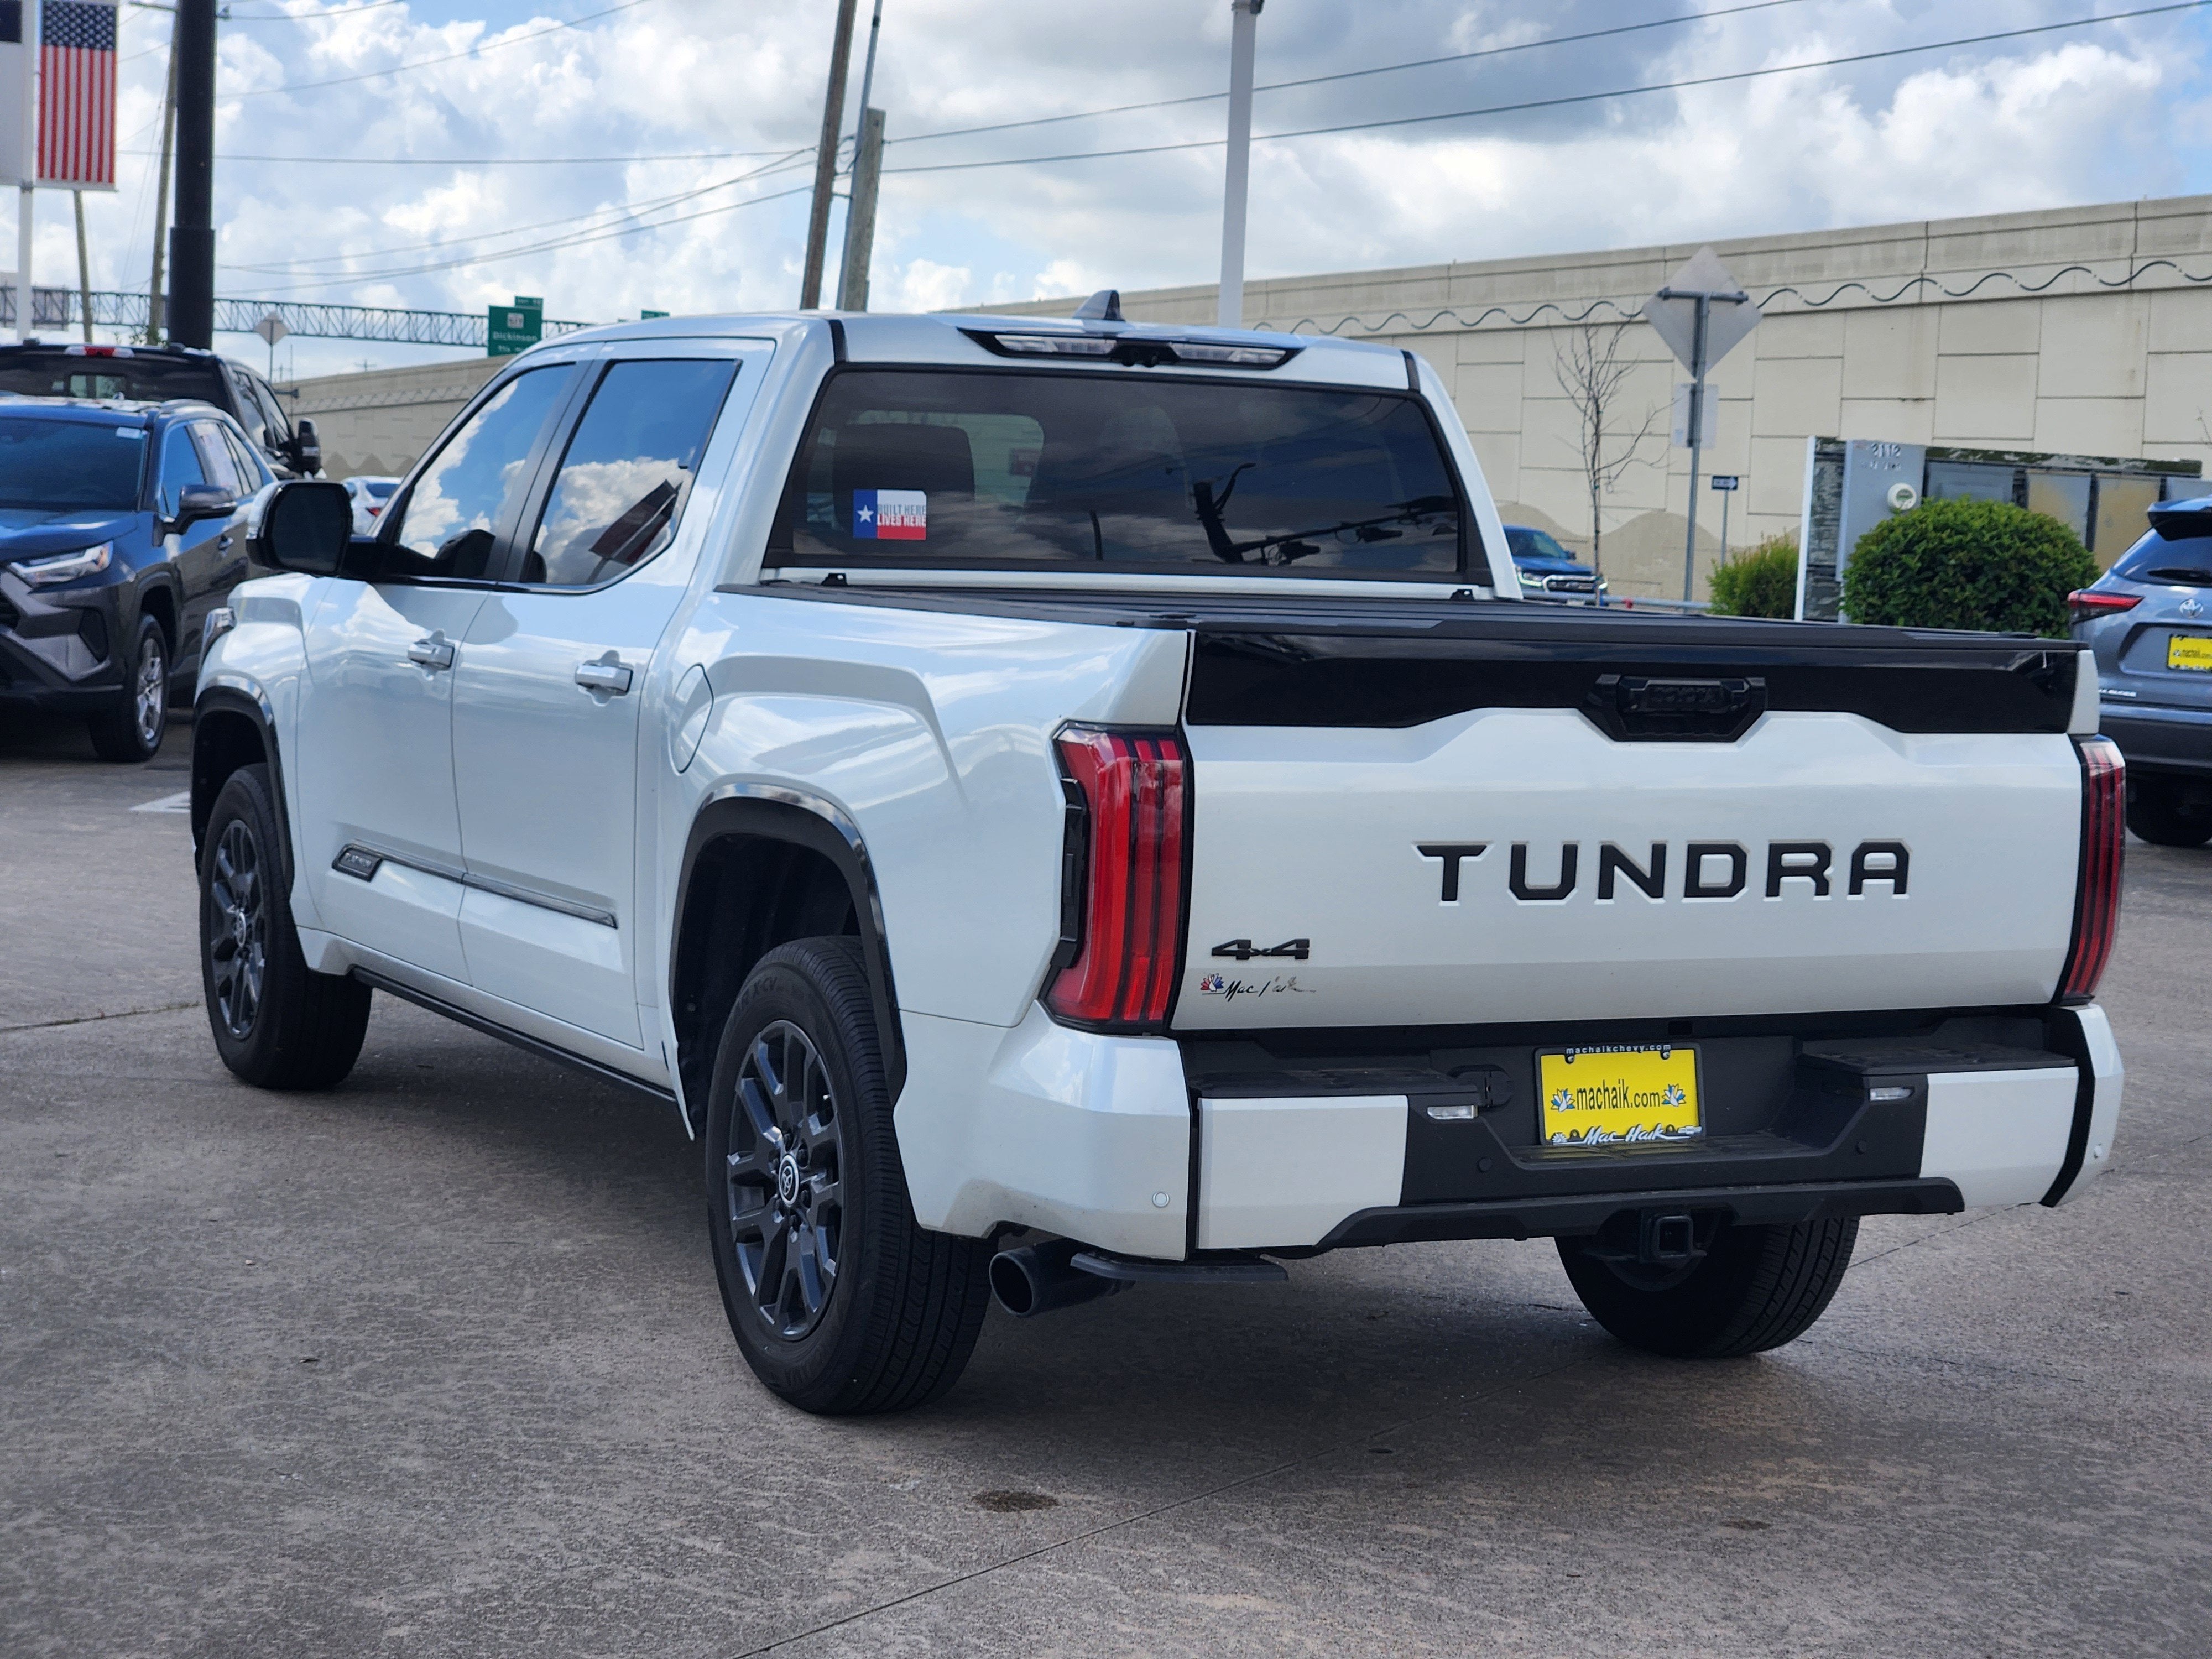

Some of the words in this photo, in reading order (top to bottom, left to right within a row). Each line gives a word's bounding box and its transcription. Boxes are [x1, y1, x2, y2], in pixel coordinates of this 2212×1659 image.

[878, 504, 902, 515] BUILT
[905, 505, 926, 515] HERE
[878, 514, 902, 526] LIVES
[904, 515, 926, 528] HERE
[1416, 842, 1911, 903] TUNDRA
[1566, 1044, 1671, 1054] machaikchevy.com
[1577, 1079, 1660, 1110] machaik.com
[1584, 1125, 1621, 1145] Mac
[1624, 1123, 1665, 1142] Haik
